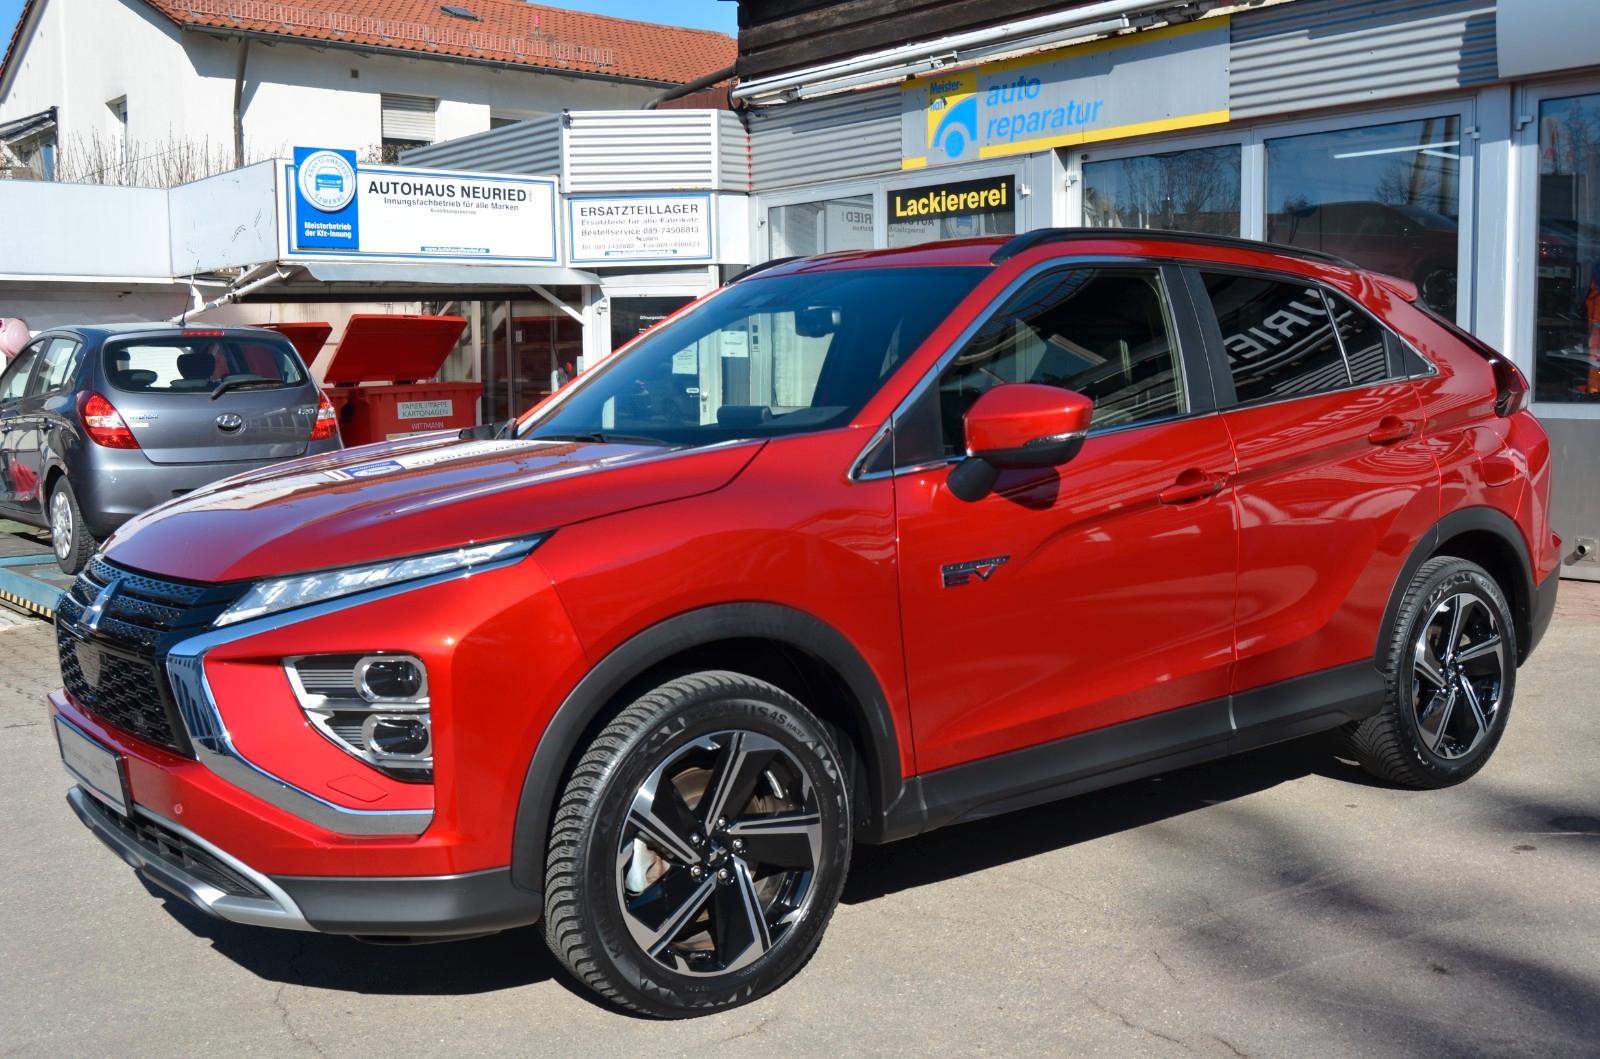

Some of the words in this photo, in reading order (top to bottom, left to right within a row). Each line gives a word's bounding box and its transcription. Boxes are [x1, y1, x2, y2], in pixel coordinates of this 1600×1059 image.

[985, 75, 1041, 107] auto
[986, 99, 1104, 142] reparatur
[368, 180, 456, 198] AUTOHAUS
[460, 185, 527, 202] NEURIED
[384, 197, 461, 208] Innungsfachbetrieb
[463, 200, 474, 208] für
[491, 202, 519, 211] Marken
[895, 183, 1007, 218] Lackiererei
[580, 203, 698, 217] ERSATZTEILLAGER
[304, 221, 352, 231] Meisterbetrieb
[581, 228, 641, 237] Bestellservice
[304, 229, 316, 238] der
[316, 230, 352, 239] Kfz-Innung
